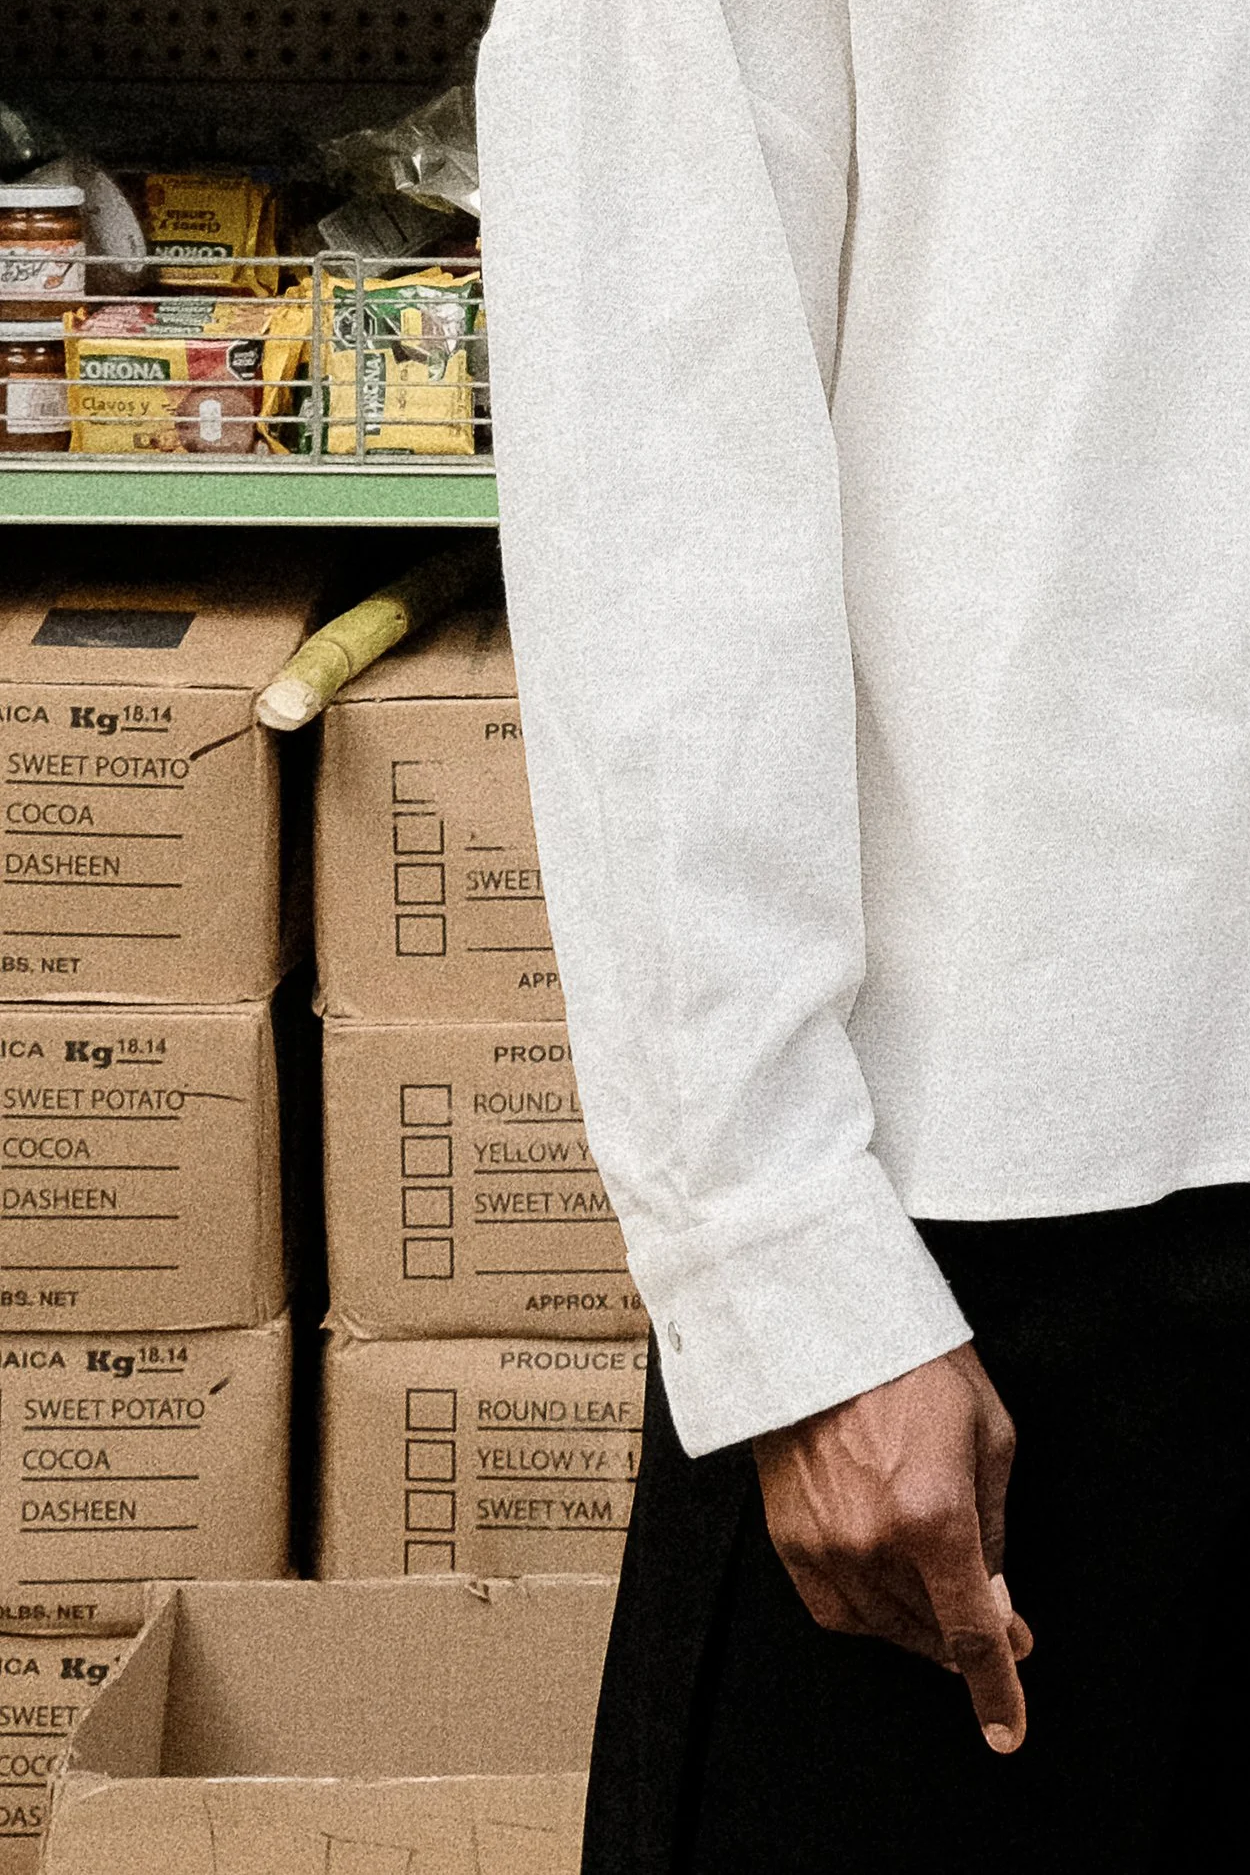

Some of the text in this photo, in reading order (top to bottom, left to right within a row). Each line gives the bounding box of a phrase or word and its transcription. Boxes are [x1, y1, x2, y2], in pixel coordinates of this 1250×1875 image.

[82, 397, 149, 414] Clavos y
[70, 705, 173, 736] Kg 18.14
[7, 753, 190, 779] SWEET POTATO
[6, 803, 94, 825] COCOA
[5, 853, 121, 876] DASHEEN
[466, 869, 542, 891] SWEET
[41, 957, 81, 974] NET
[64, 1038, 166, 1069] Kg 18.14
[3, 1088, 185, 1111] SWEET POTATO
[473, 1092, 562, 1114] ROUND
[2, 1137, 91, 1159] COCOA
[474, 1143, 569, 1163] YELLOW
[2, 1189, 118, 1210] DASHEEN
[474, 1192, 613, 1214] SWEET YAM
[39, 1291, 79, 1307] NET
[525, 1295, 608, 1311] APPROX
[86, 1346, 189, 1378] Kg 18.14
[501, 1352, 627, 1372] PRODUCE
[24, 1398, 206, 1420] SWEET POTATO
[477, 1400, 631, 1422] ROUND LEAF
[22, 1449, 111, 1471] COCOA
[477, 1448, 574, 1471] YELLOW
[21, 1499, 136, 1522] DASHEEN
[477, 1499, 612, 1521] SWEET YAM
[57, 1605, 99, 1620] NET
[0, 1706, 79, 1726] SWEET
